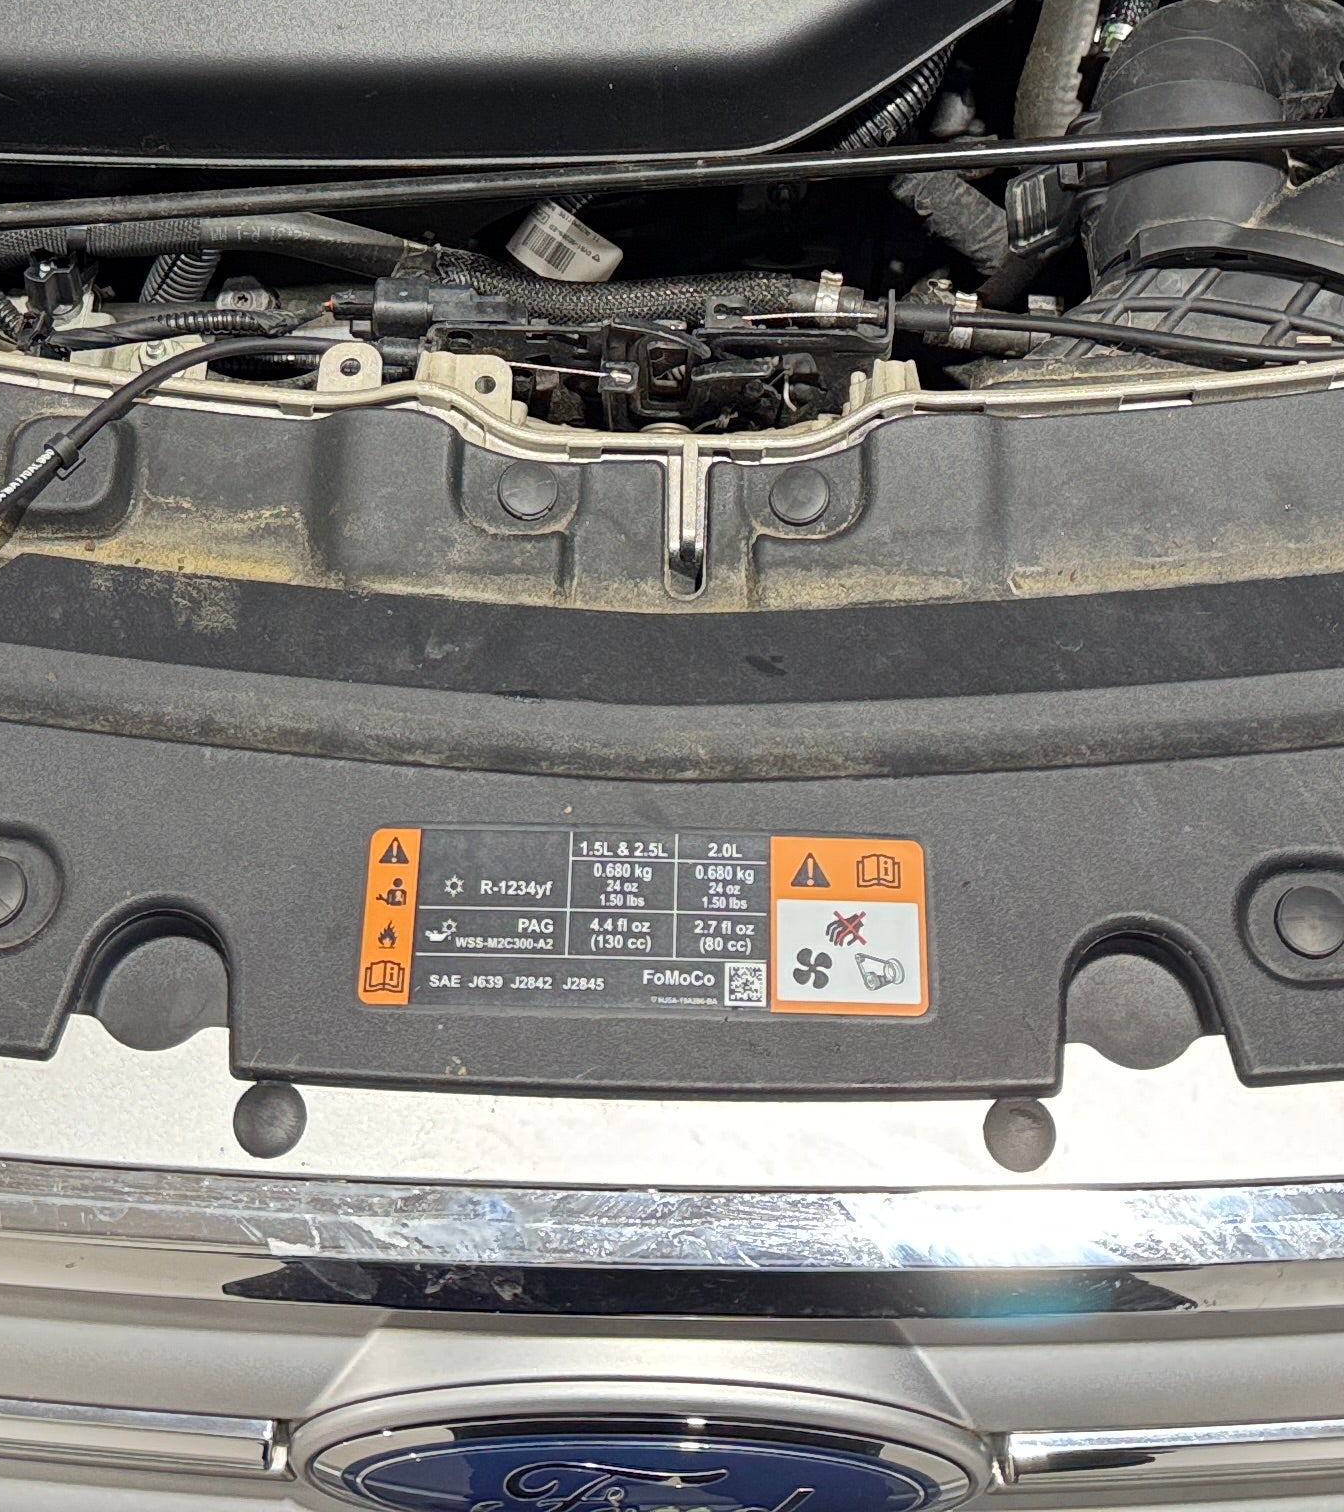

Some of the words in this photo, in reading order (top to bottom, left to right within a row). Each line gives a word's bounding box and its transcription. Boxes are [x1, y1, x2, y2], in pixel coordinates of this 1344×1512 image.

[580, 842, 613, 857] 1.5L
[618, 842, 629, 857] &
[634, 843, 667, 858] 2.5L
[708, 844, 741, 858] 2.0L
[594, 865, 630, 880] 0.680
[633, 864, 653, 882] kg
[696, 866, 732, 882] 0.680
[736, 866, 755, 885] kg
[481, 880, 551, 899] R-1234yf
[606, 881, 620, 893] 24
[624, 883, 637, 893] oz
[708, 883, 722, 895] 24
[725, 886, 739, 895] oz
[600, 895, 623, 907] 1.50
[626, 895, 644, 907] lbs
[702, 897, 725, 909] 1.50
[729, 897, 747, 910] lbs
[518, 918, 553, 933] PAG
[590, 918, 611, 932] 4.4
[615, 918, 627, 933] fl
[630, 922, 650, 933] oz
[694, 920, 716, 934] 2.7
[720, 920, 731, 934] fl
[735, 924, 754, 935] oz
[456, 936, 553, 950] WSS-M2C300-A2
[591, 935, 624, 953] (130
[628, 935, 651, 953] cc)
[699, 937, 724, 954] (80
[727, 937, 751, 954] cc)
[429, 974, 460, 988] SAE
[468, 975, 503, 988] J639
[510, 975, 552, 989] J2842
[563, 976, 604, 990] J2845
[643, 970, 715, 987] FoMoCo
